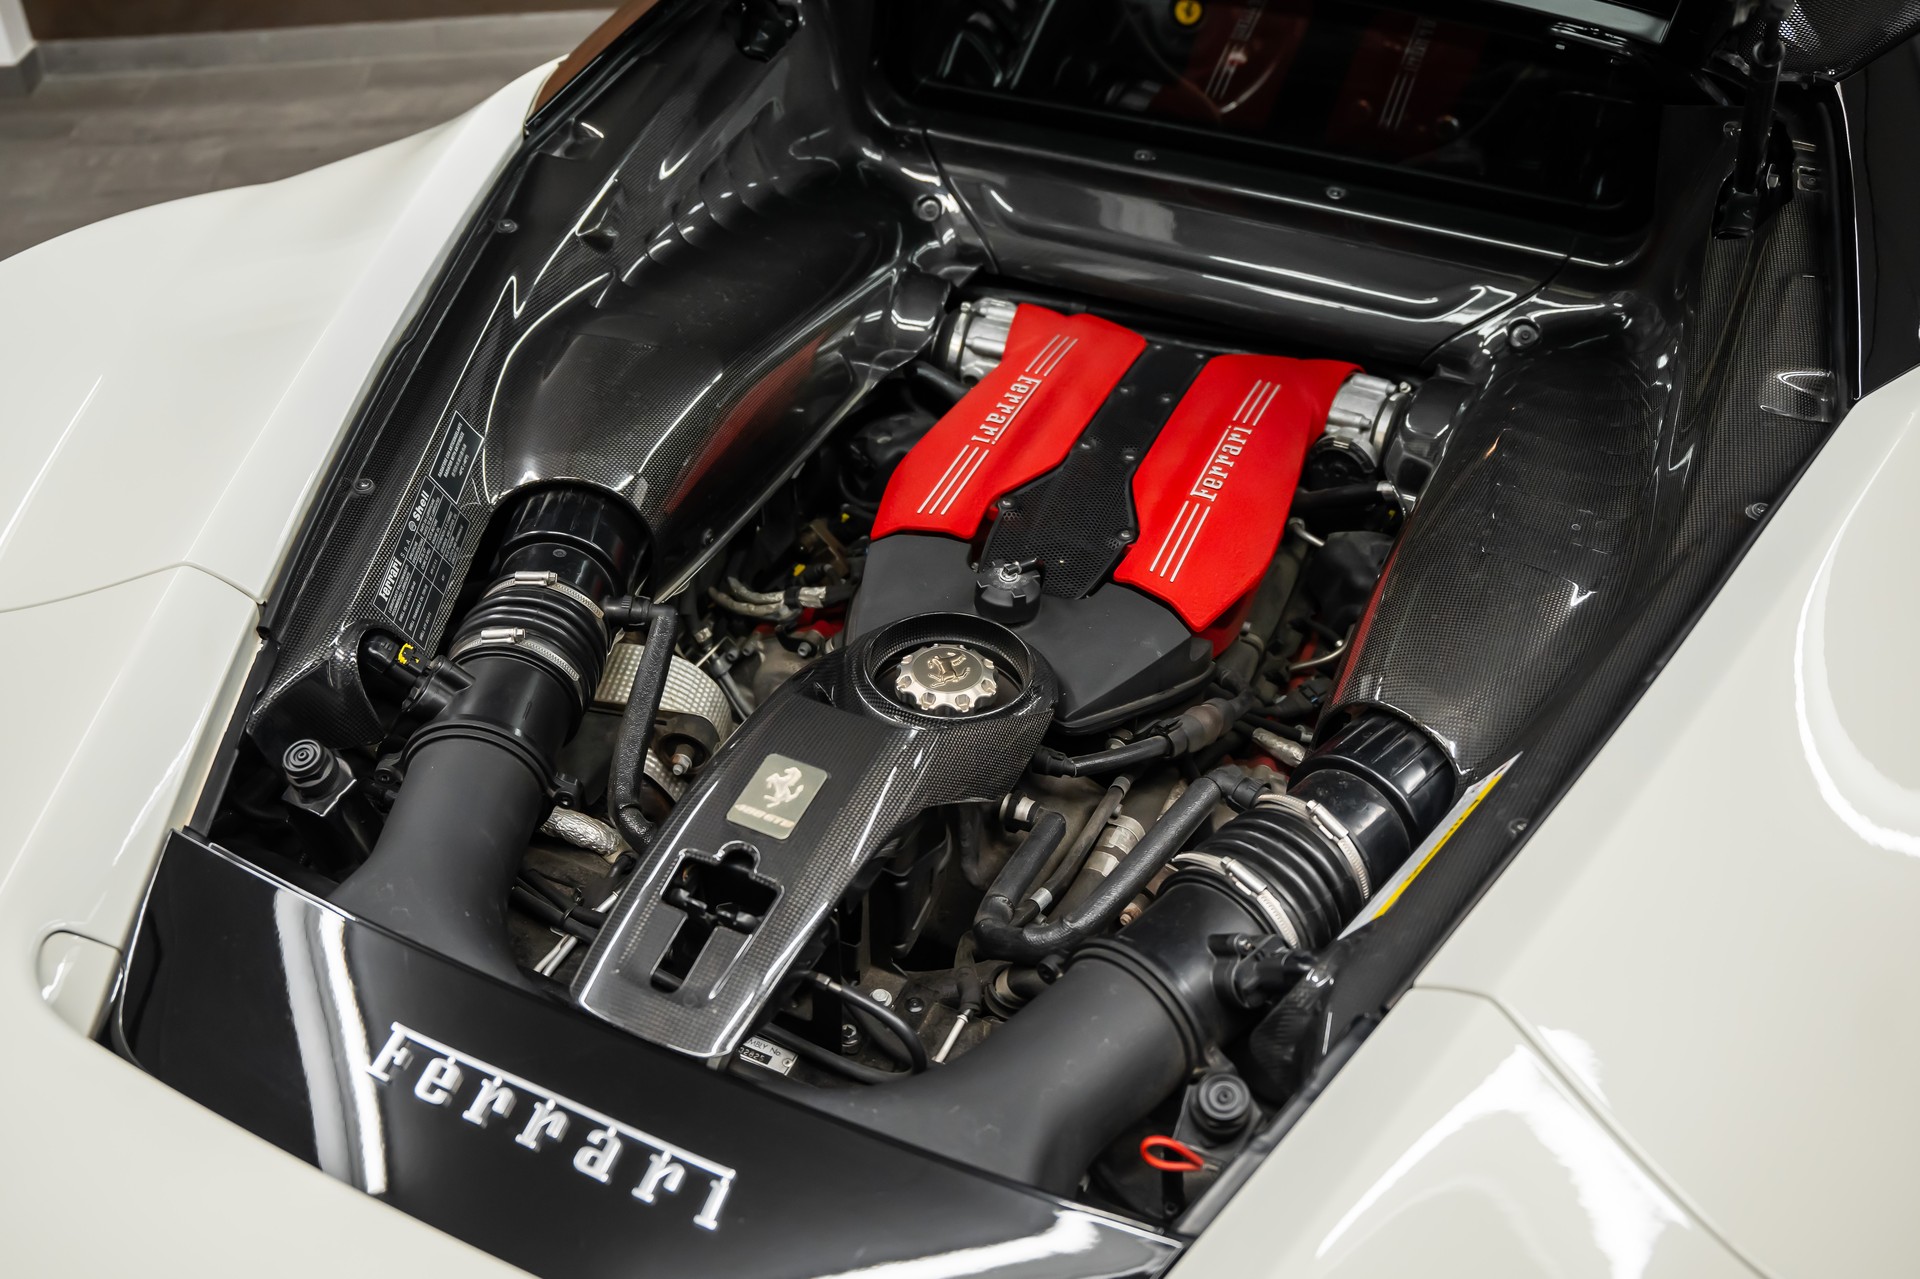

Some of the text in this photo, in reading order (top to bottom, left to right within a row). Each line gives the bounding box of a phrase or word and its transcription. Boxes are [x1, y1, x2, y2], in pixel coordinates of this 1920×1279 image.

[972, 375, 1042, 445] Ferrari
[1190, 425, 1253, 502] Ferrari
[379, 556, 402, 602] Ferrari
[413, 490, 429, 521] Shell
[747, 1038, 768, 1050] MBLY
[364, 1020, 737, 1231] Ferrari
